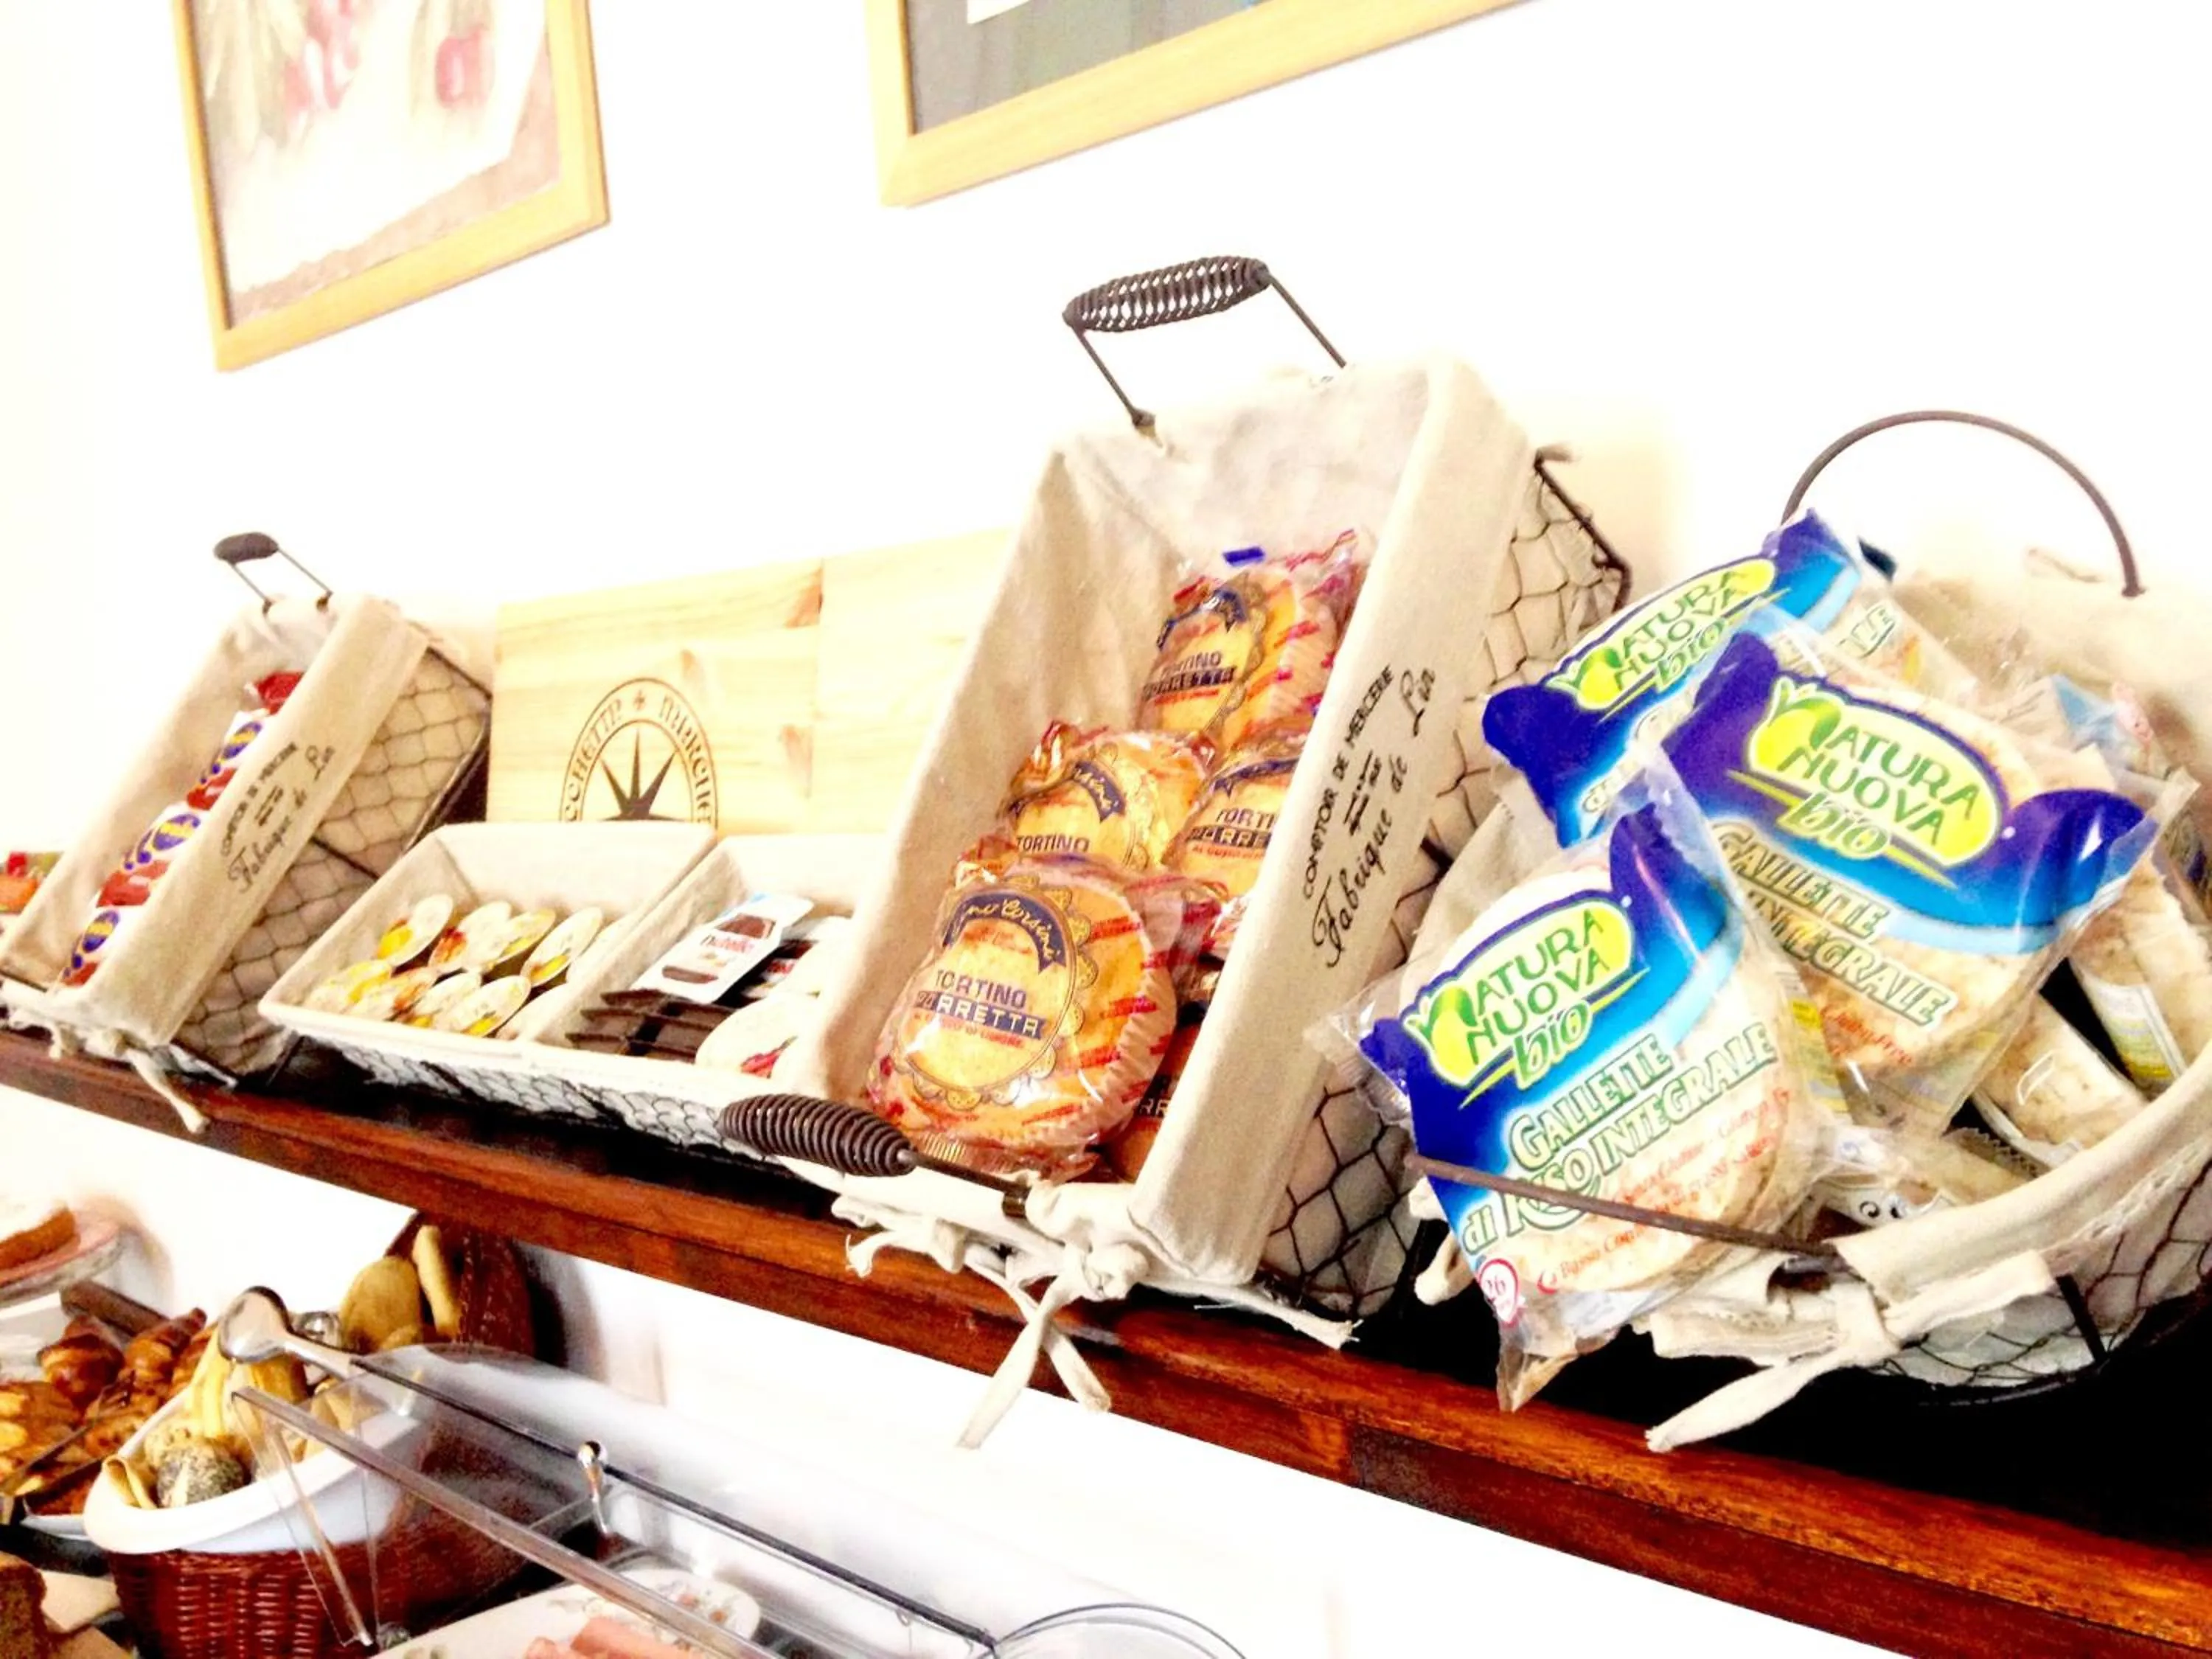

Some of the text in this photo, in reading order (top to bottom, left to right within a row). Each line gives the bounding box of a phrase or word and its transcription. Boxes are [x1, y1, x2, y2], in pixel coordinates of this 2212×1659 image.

[1615, 588, 1745, 690] NUOVA
[1656, 618, 1725, 683] bio
[1217, 807, 1275, 829] TORTI
[1304, 663, 1394, 899] COMPTOIR DE MERCERIE
[1312, 809, 1392, 967] Fabrique
[1389, 754, 1408, 793] de
[1400, 669, 1436, 737] Lin
[1777, 746, 1945, 847] NUOVA
[1778, 792, 1888, 855] bio
[1017, 832, 1091, 852] TORTINO
[1713, 820, 1891, 939] GALLETTE
[935, 969, 1028, 1010] TORTINO
[1466, 946, 1611, 1065] NUOVA
[1514, 1002, 1587, 1082] bio
[1509, 1034, 1674, 1172] GALLETTE
[1588, 1020, 1778, 1177] INTEGRALE
